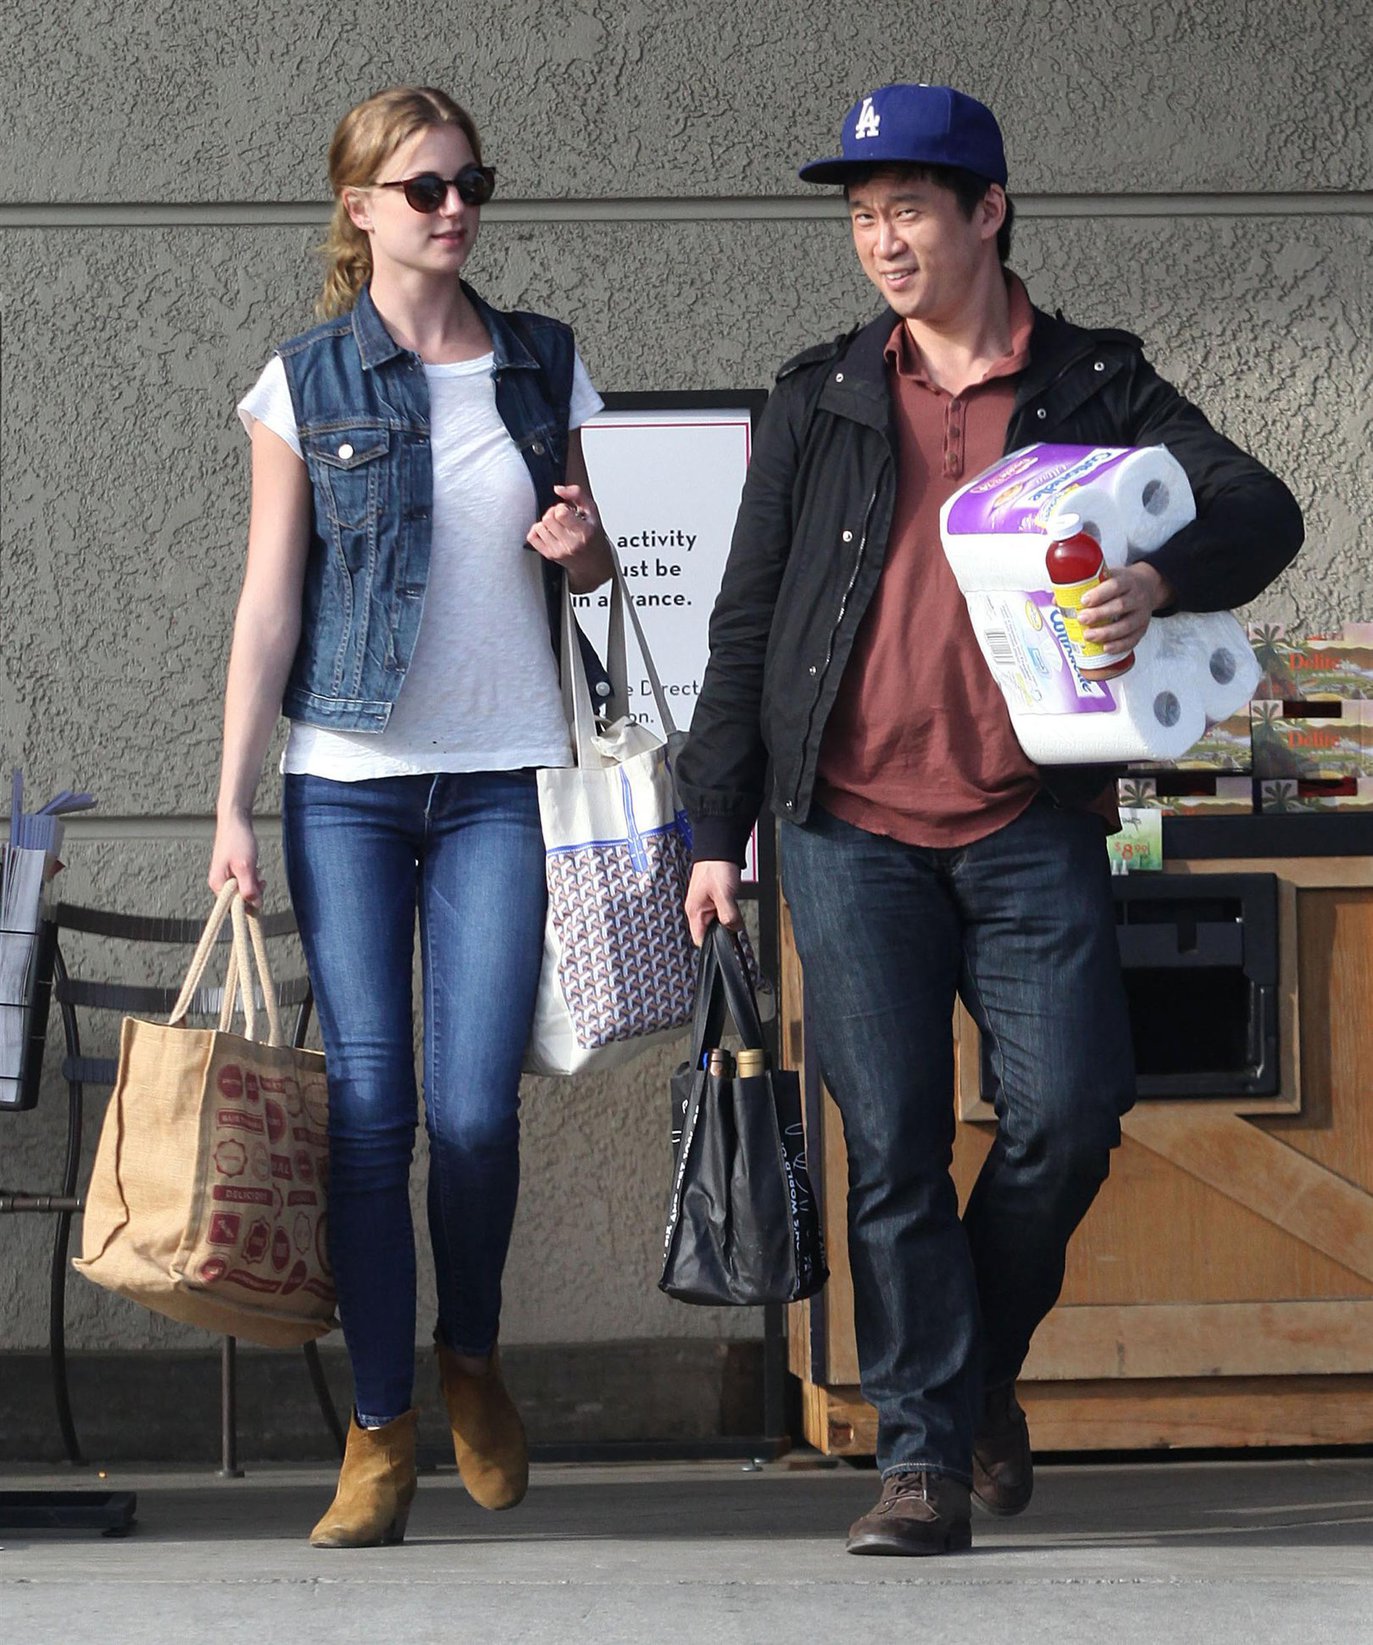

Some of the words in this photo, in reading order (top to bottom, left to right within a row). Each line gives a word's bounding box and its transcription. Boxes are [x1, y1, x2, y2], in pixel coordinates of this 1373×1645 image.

[855, 97, 880, 140] LA
[617, 530, 697, 552] activity
[621, 560, 648, 577] ust
[655, 558, 681, 577] be
[597, 593, 692, 608] aance.
[640, 679, 700, 697] Drect
